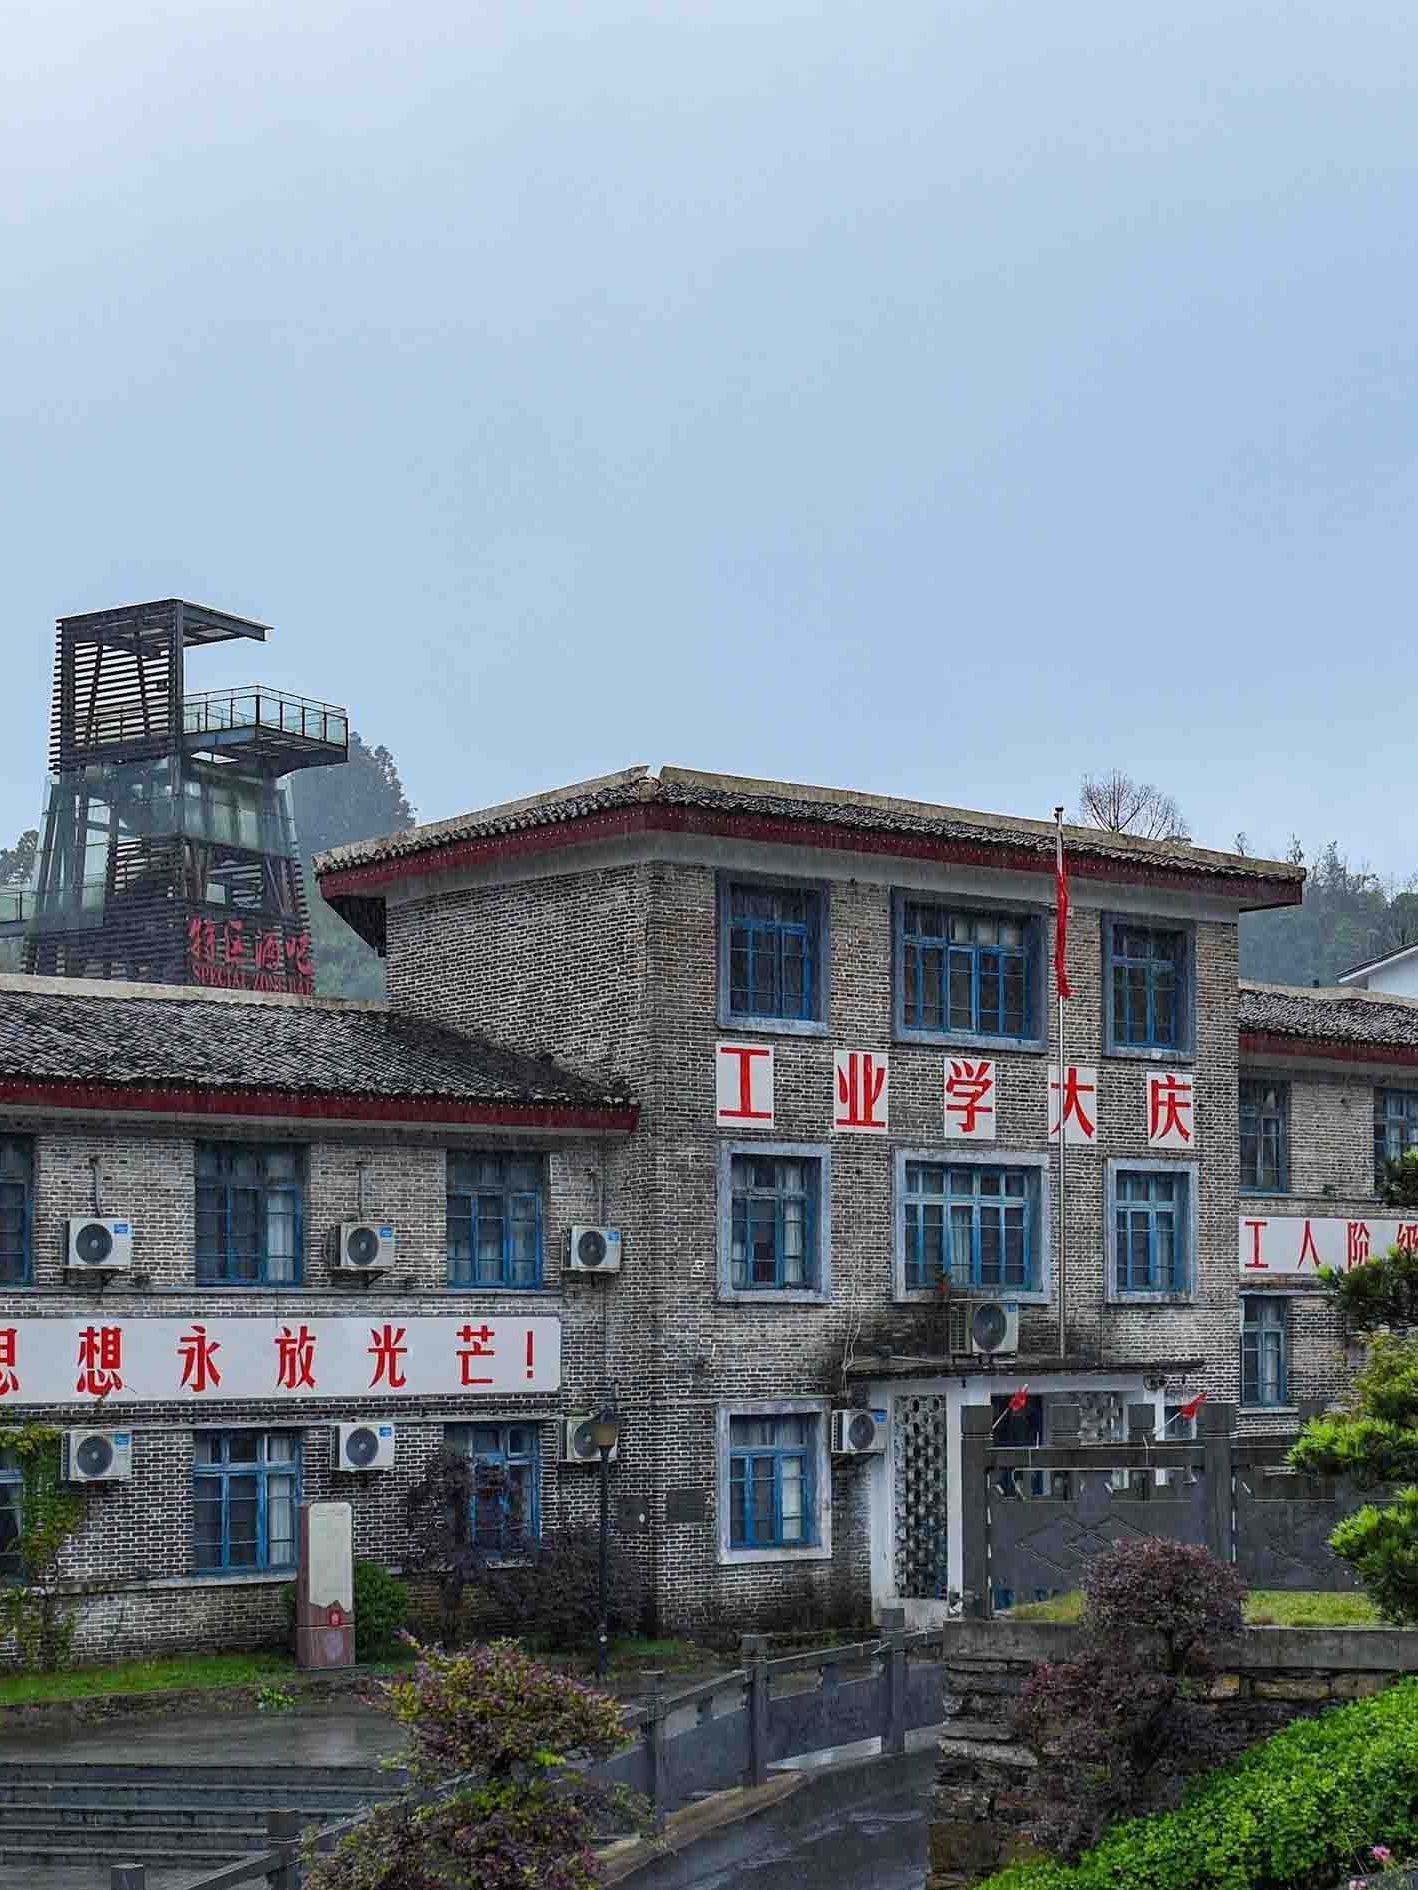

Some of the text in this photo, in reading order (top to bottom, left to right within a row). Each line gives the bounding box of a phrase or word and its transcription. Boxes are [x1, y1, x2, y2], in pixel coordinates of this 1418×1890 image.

[719, 1046, 1192, 1143] 工业学大庆
